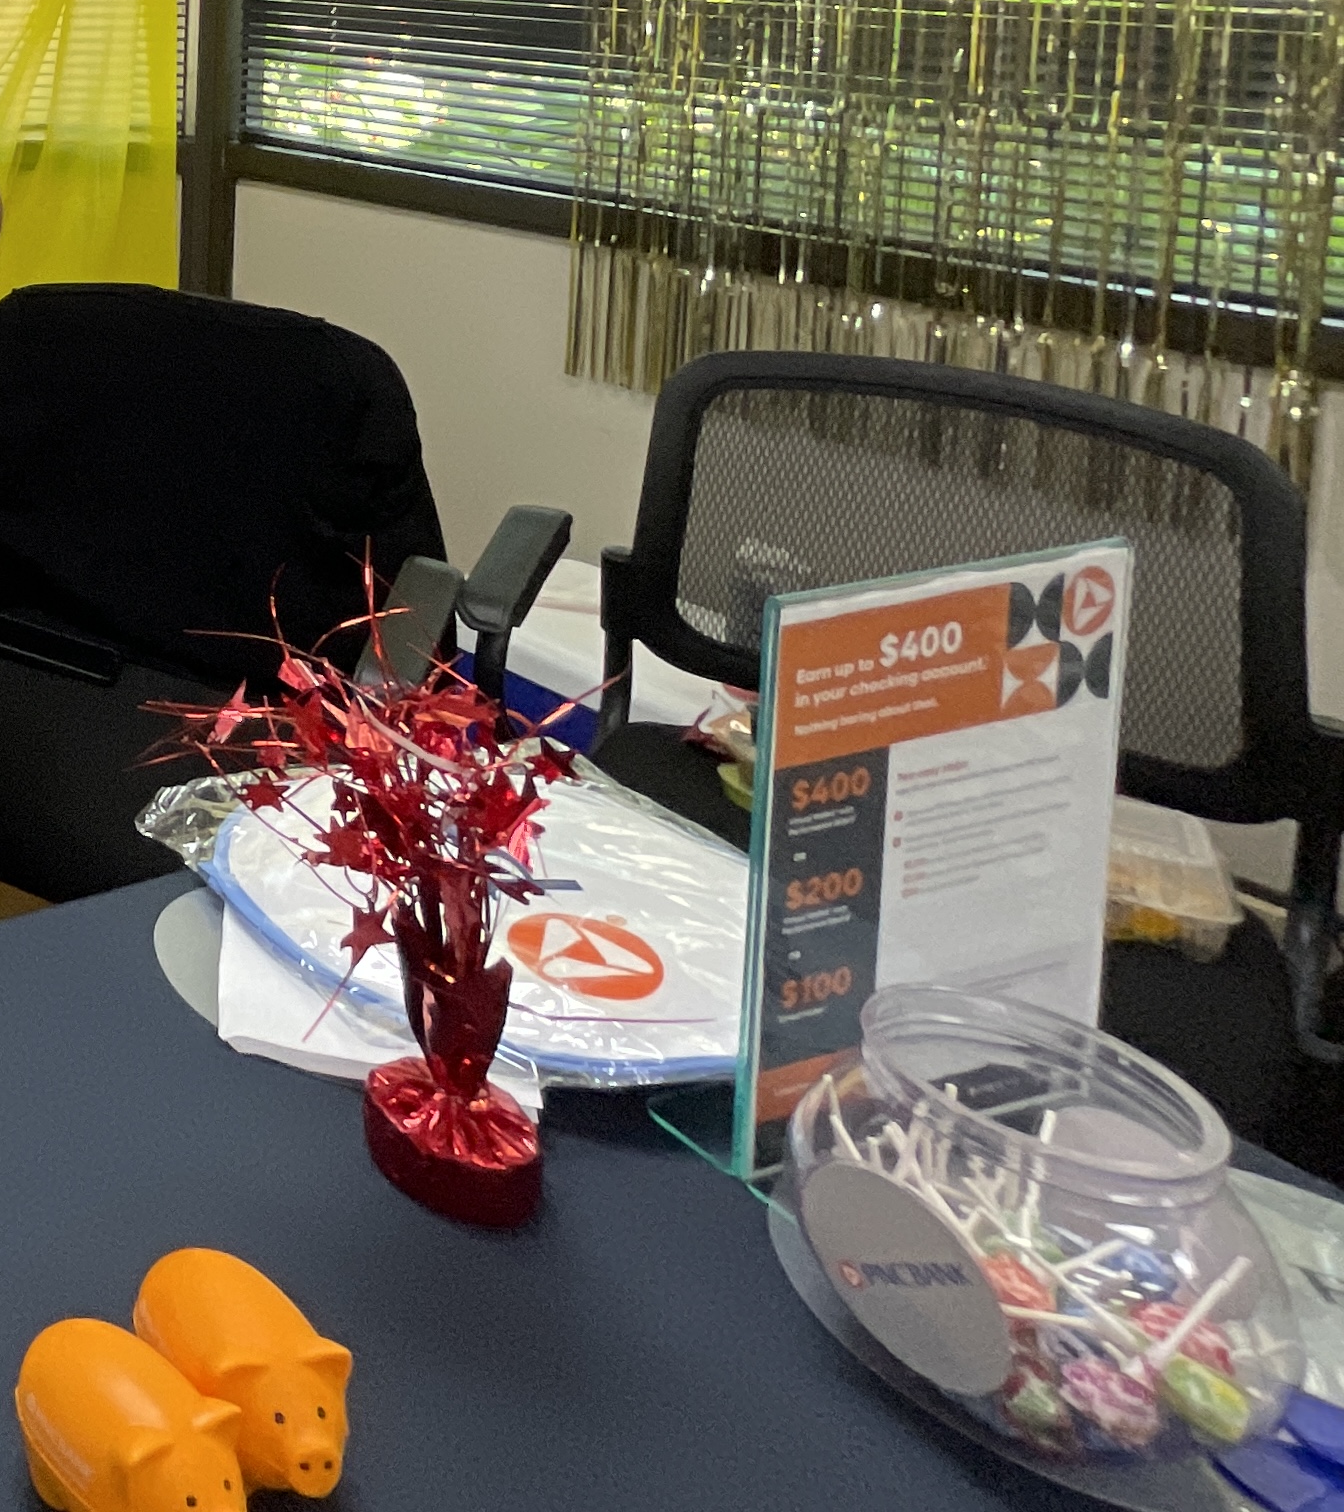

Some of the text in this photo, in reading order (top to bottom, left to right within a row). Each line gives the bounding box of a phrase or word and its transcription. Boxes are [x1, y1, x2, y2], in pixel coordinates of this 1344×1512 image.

[796, 621, 963, 685] Earn up to $400
[794, 692, 810, 708] in
[813, 687, 848, 707] your
[849, 671, 919, 696] checking
[791, 766, 871, 812] $400
[785, 867, 863, 910] $200
[780, 966, 853, 1009] $100
